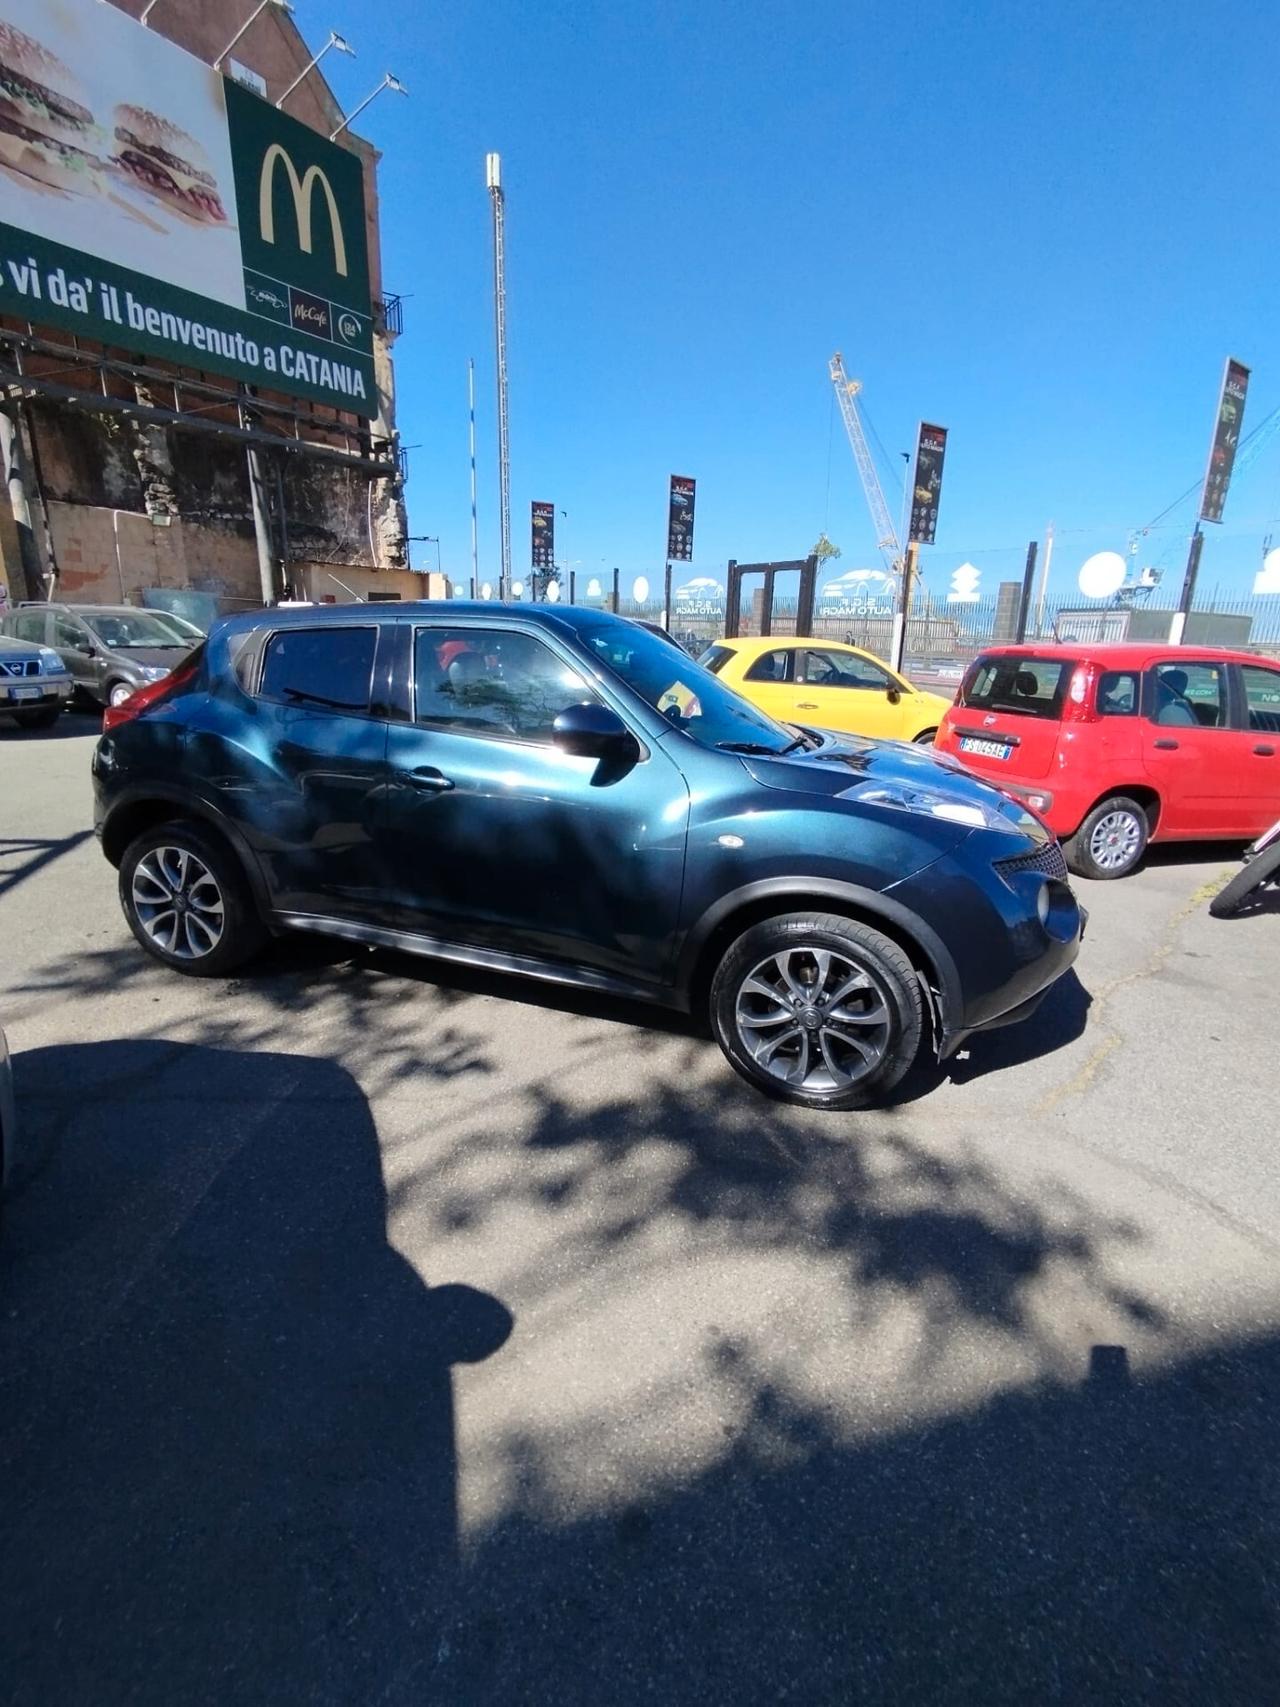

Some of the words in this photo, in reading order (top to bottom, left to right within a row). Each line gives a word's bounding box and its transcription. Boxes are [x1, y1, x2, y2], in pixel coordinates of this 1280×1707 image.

[7, 258, 41, 299] vi
[47, 268, 93, 314] da'
[100, 283, 122, 325] il
[127, 290, 260, 367] benvenuto
[264, 347, 276, 372] a
[279, 345, 367, 400] CATANIA
